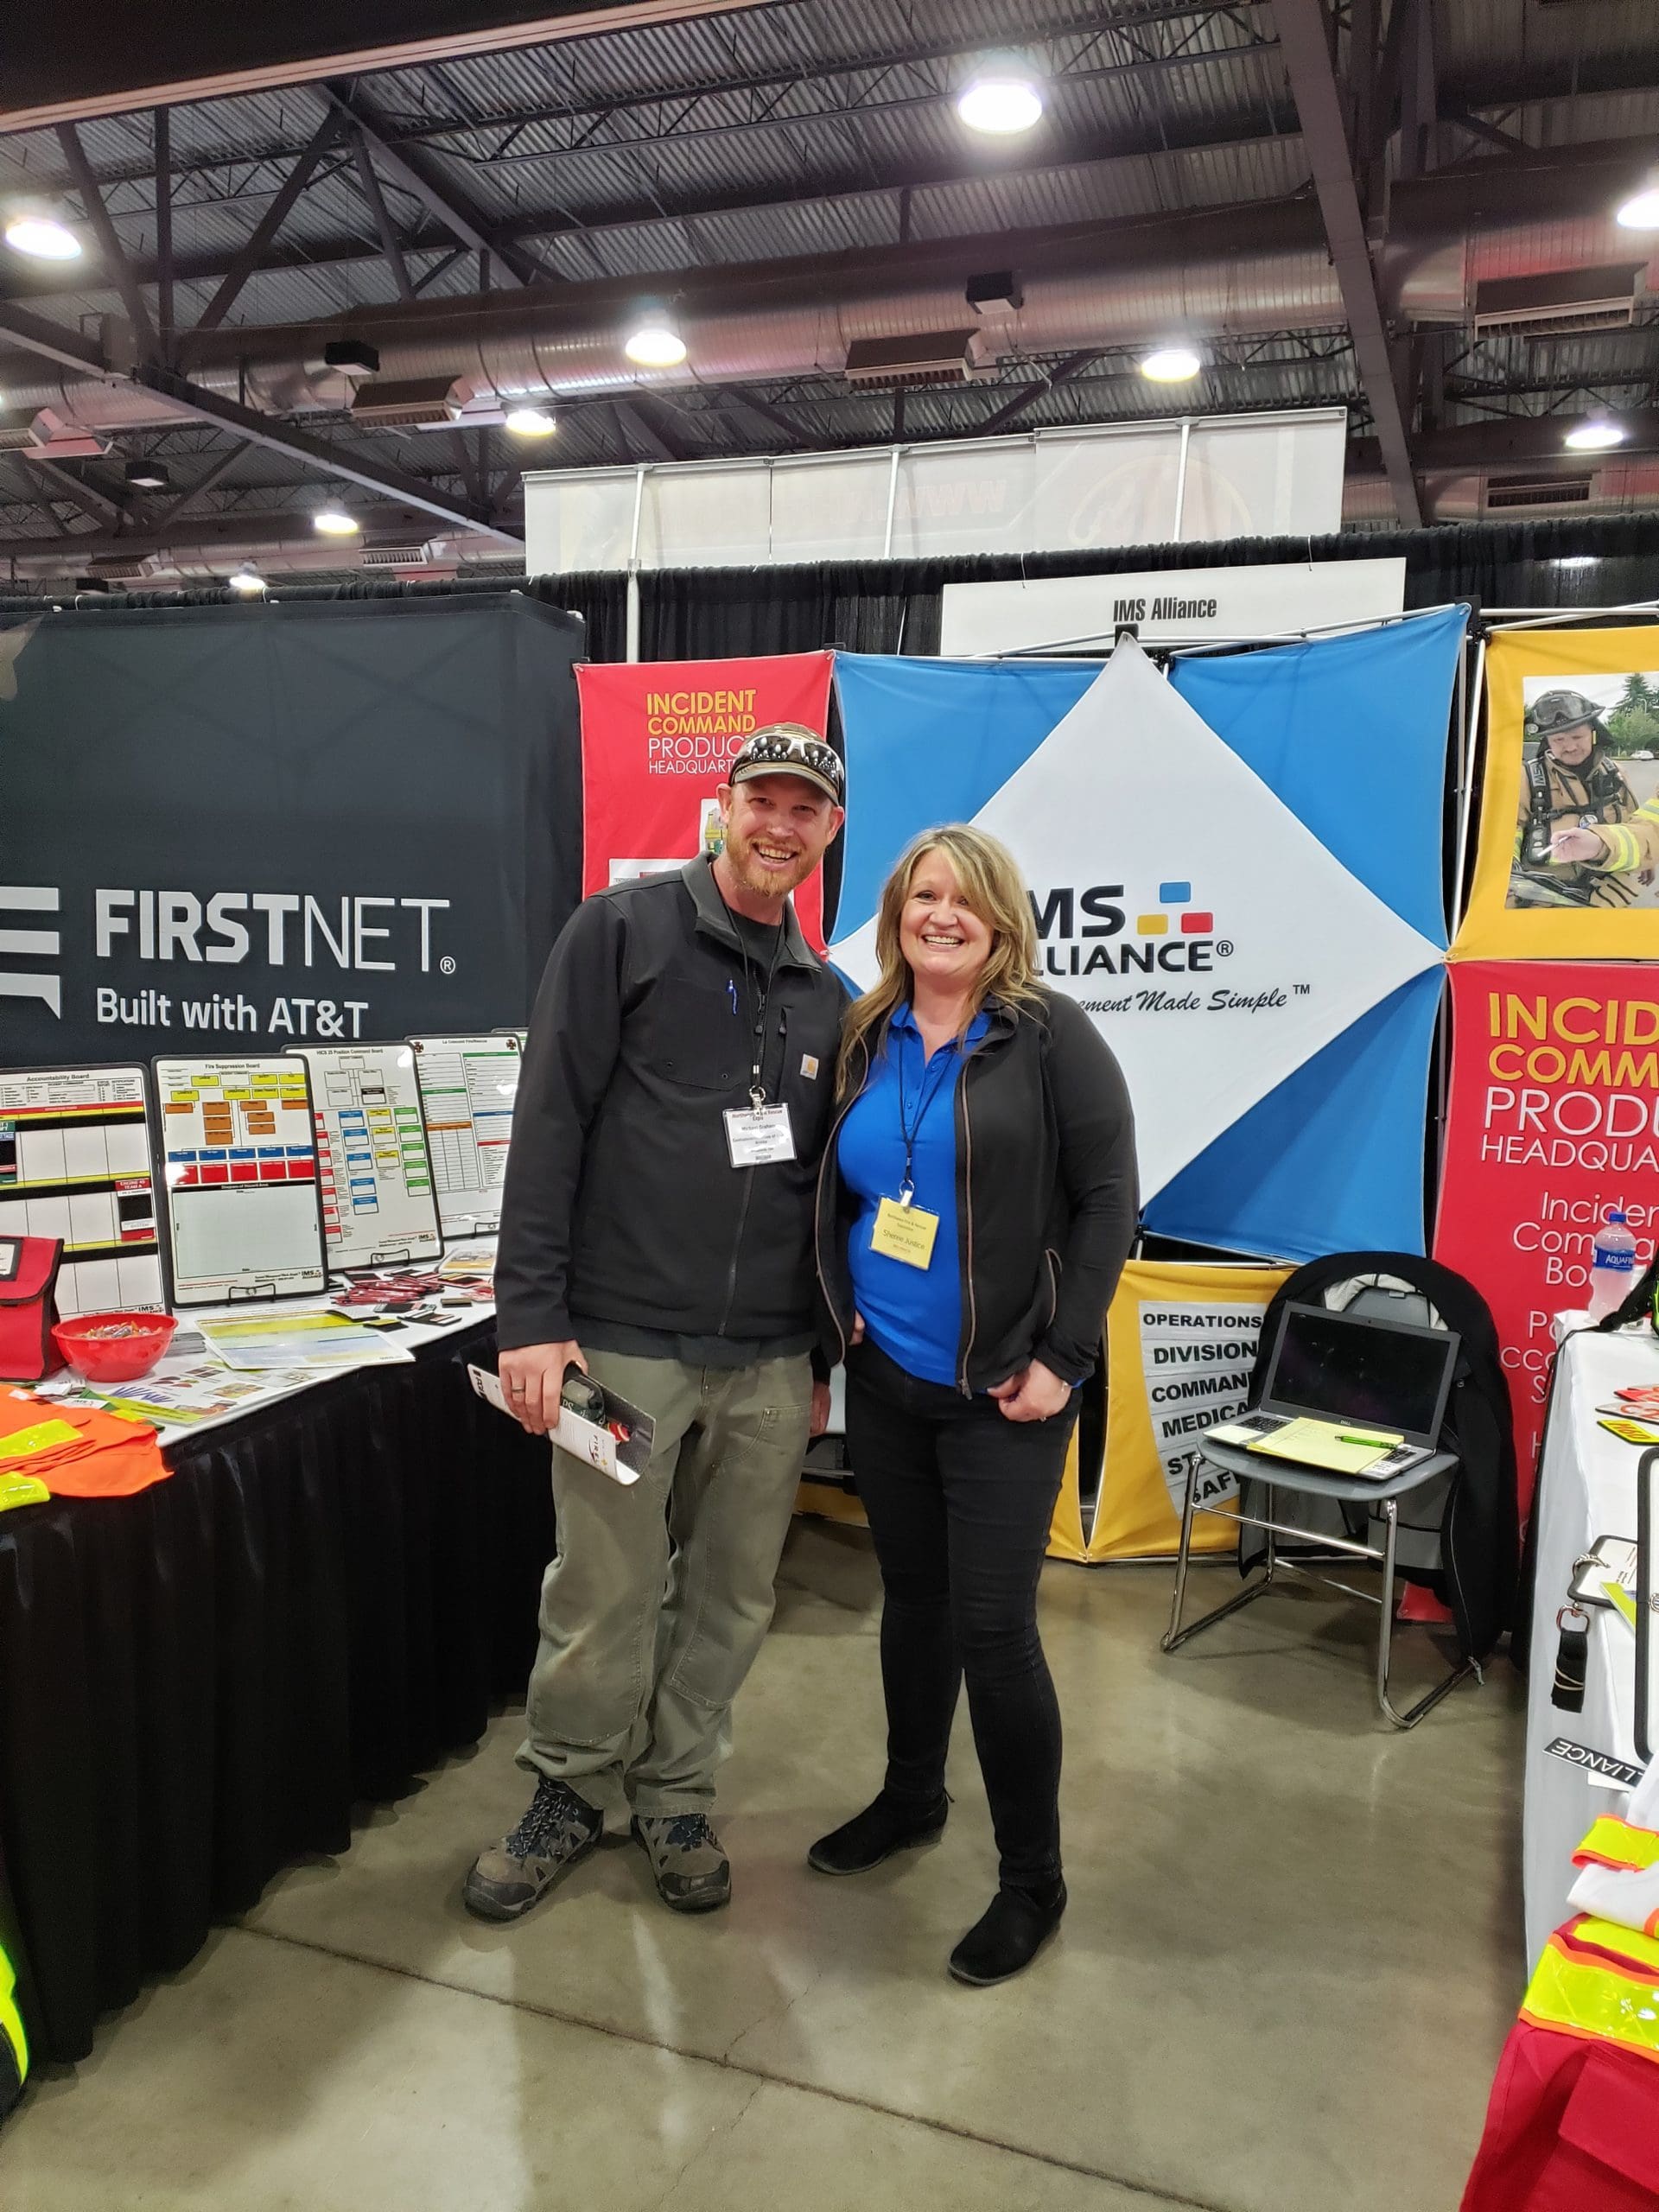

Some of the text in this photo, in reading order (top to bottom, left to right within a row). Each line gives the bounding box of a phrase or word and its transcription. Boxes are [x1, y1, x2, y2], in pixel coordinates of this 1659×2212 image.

[1113, 597, 1217, 622] IMS Alliance
[647, 690, 756, 715] INCIDENT
[648, 715, 756, 735] COMMAND
[649, 759, 735, 774] HEADQUART
[96, 988, 369, 1039] Built with AT&T
[1135, 990, 1201, 1013] Made
[1207, 988, 1287, 1014] Simple
[27, 1073, 69, 1083] Accountability
[1484, 1086, 1659, 1139] PROD
[1143, 1313, 1262, 1329] OPERATIONS
